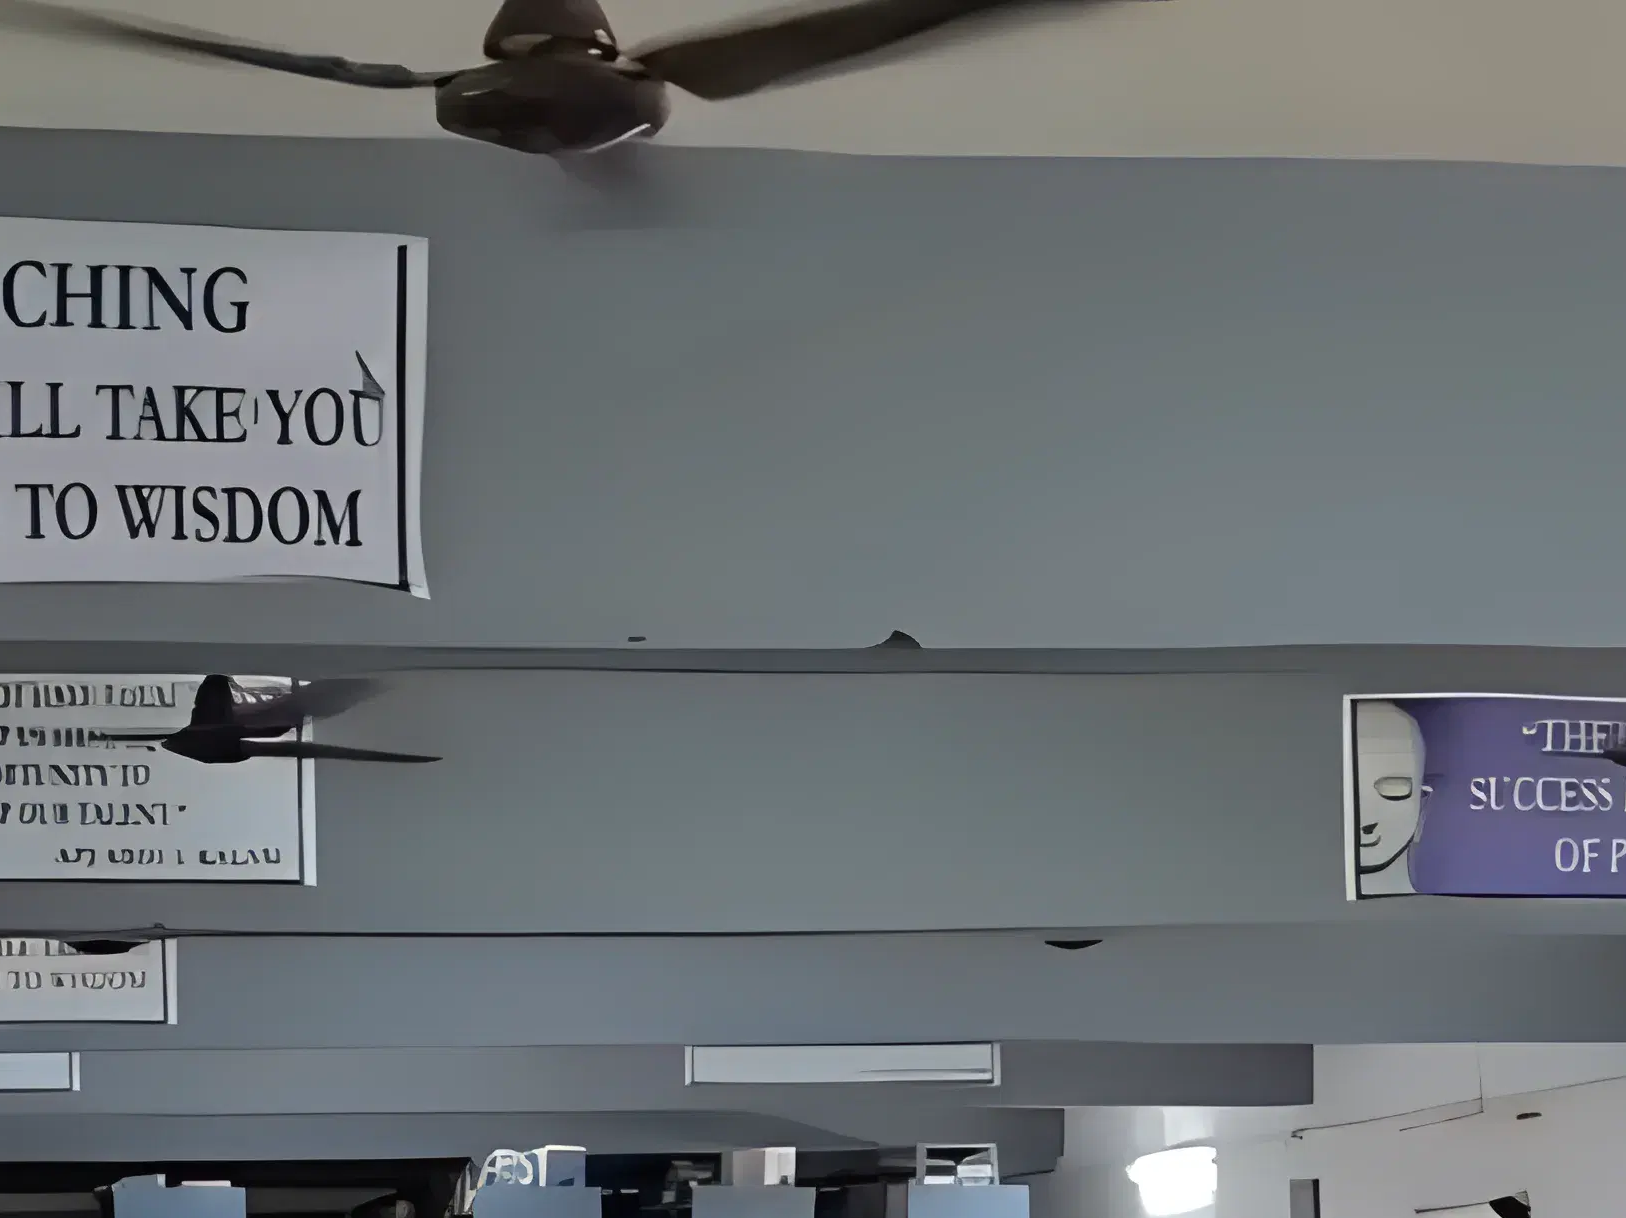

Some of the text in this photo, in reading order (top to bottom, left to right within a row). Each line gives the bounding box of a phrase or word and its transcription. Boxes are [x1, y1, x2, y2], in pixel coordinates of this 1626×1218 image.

[96, 385, 247, 442] TAKE
[266, 386, 385, 446] YOU
[15, 483, 97, 540] TO
[115, 485, 362, 546] WISDOM
[1470, 777, 1612, 811] SUCCESS
[1555, 838, 1600, 872] OF
